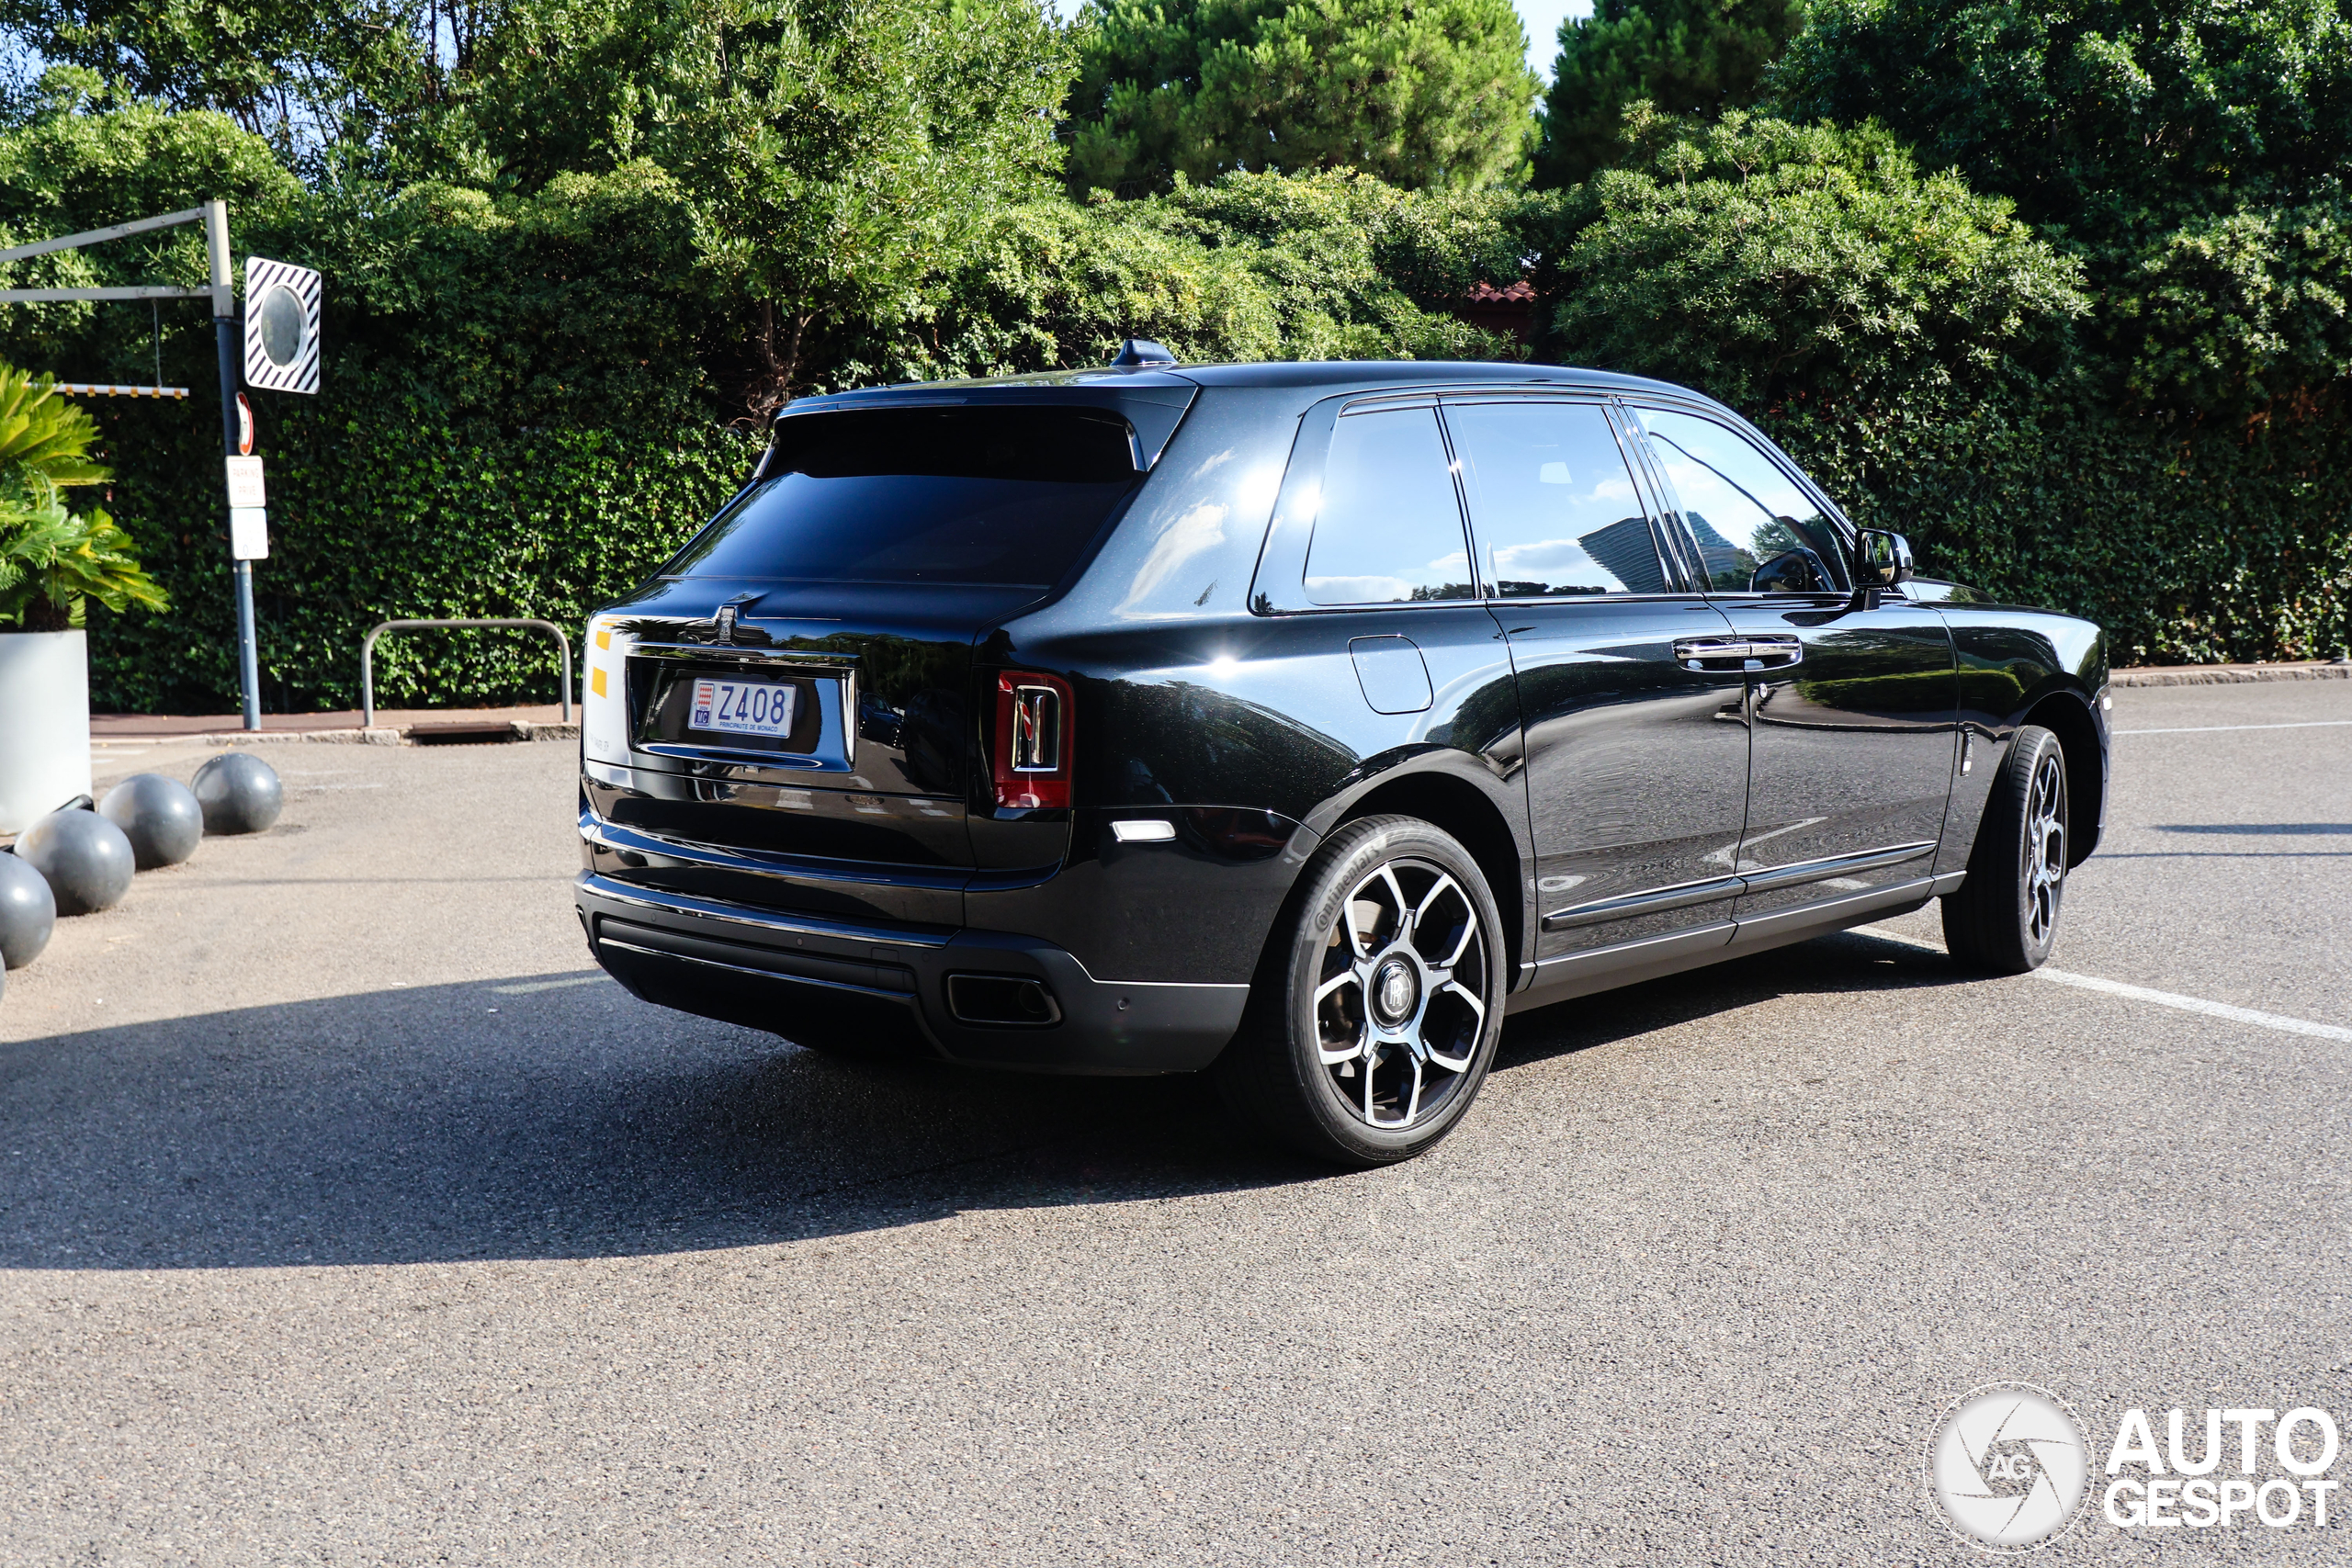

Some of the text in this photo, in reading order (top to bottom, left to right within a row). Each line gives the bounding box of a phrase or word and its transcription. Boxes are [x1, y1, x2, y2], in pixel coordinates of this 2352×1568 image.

[232, 468, 260, 478] PARKING
[718, 685, 786, 725] Z408
[697, 712, 708, 723] MC
[719, 721, 749, 730] PRINCIPAUTE
[757, 725, 778, 733] MONACO
[1315, 849, 1373, 932] Continental
[1388, 979, 1404, 1007] RR
